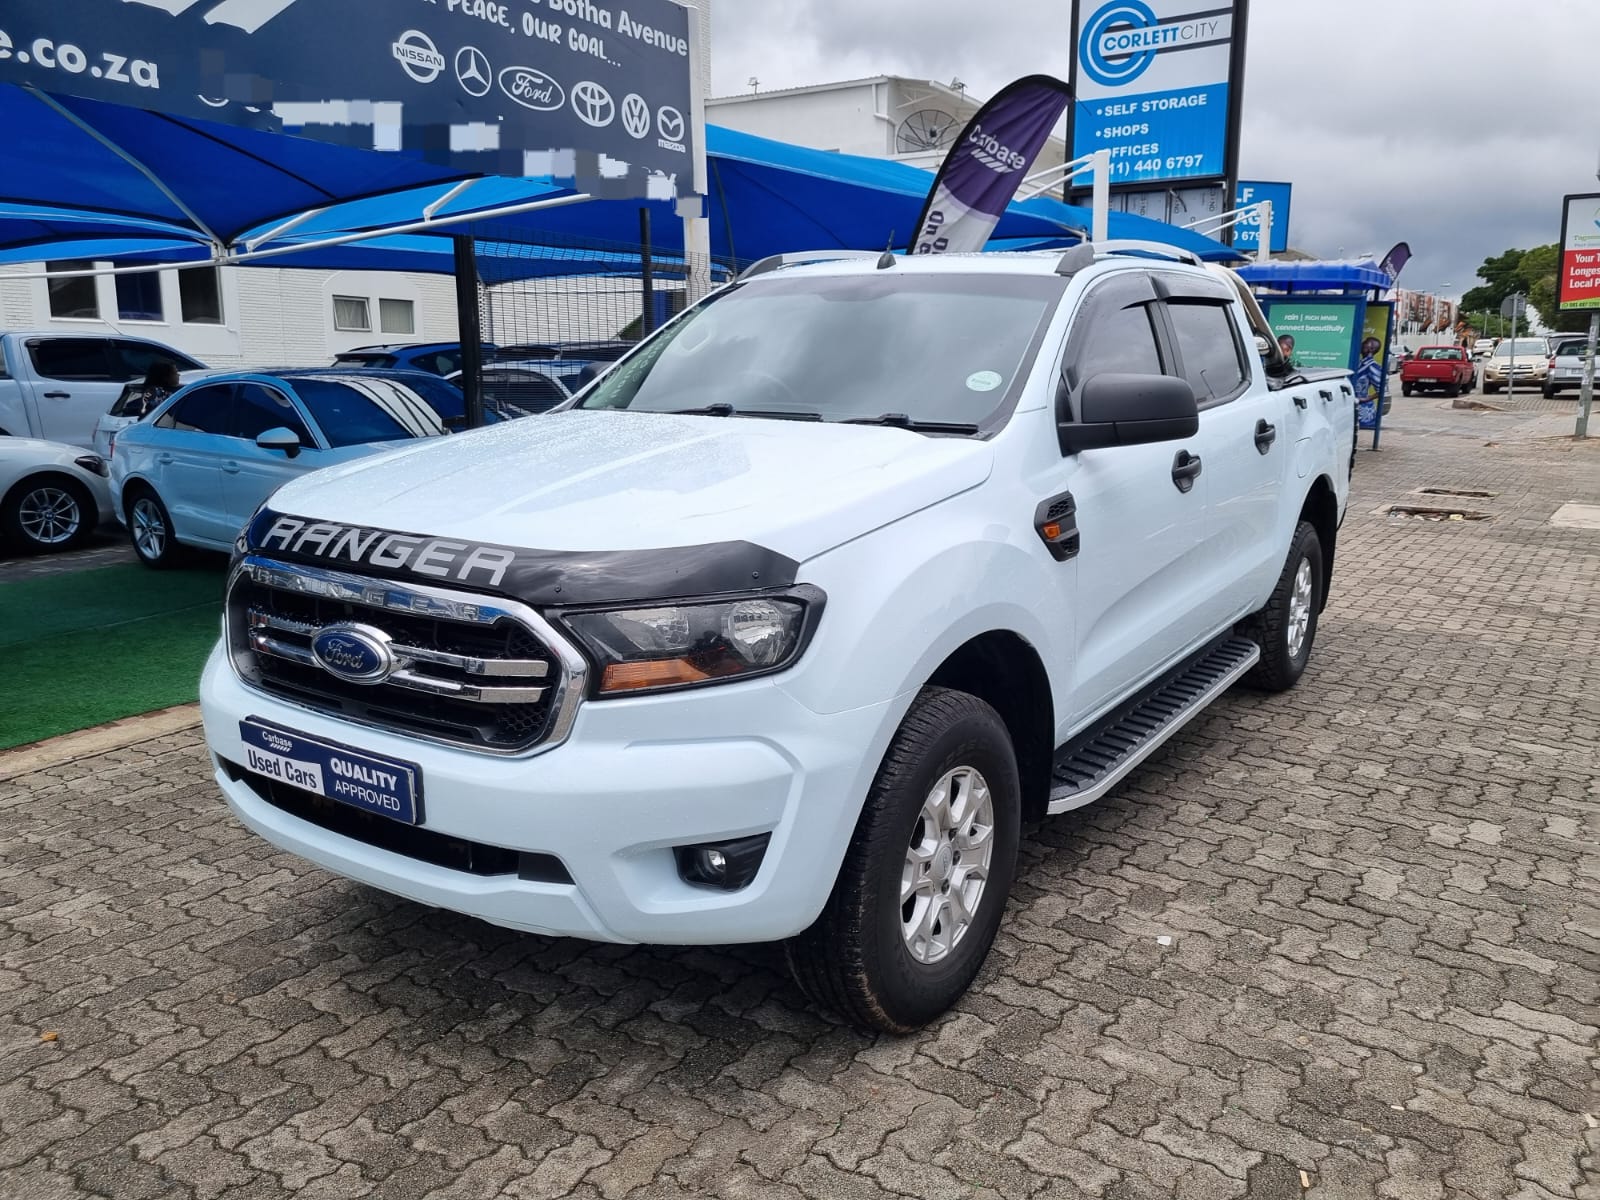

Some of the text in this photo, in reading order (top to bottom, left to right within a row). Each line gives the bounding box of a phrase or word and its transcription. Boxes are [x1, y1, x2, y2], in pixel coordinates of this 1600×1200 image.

[522, 12, 562, 44] OUR
[618, 10, 688, 56] Avenue
[396, 47, 442, 67] NISSAN
[511, 71, 552, 105] Ford
[1104, 94, 1207, 117] SELF STORAGE
[1103, 123, 1149, 139] SHOPS
[969, 125, 1026, 170] Carbase
[1109, 143, 1159, 158] FFICES
[1134, 158, 1162, 171] 440
[1166, 154, 1203, 169] 6797
[1575, 254, 1594, 264] Your
[1569, 265, 1600, 277] Longes
[1569, 278, 1593, 288] Local
[1275, 323, 1345, 333] connect beautifully
[260, 517, 515, 586] RANGER
[323, 638, 365, 669] Ford
[262, 731, 293, 748] Carbase
[247, 749, 317, 789] Used Cars
[330, 757, 399, 791] QUALITY
[335, 780, 400, 811] APPROVED
